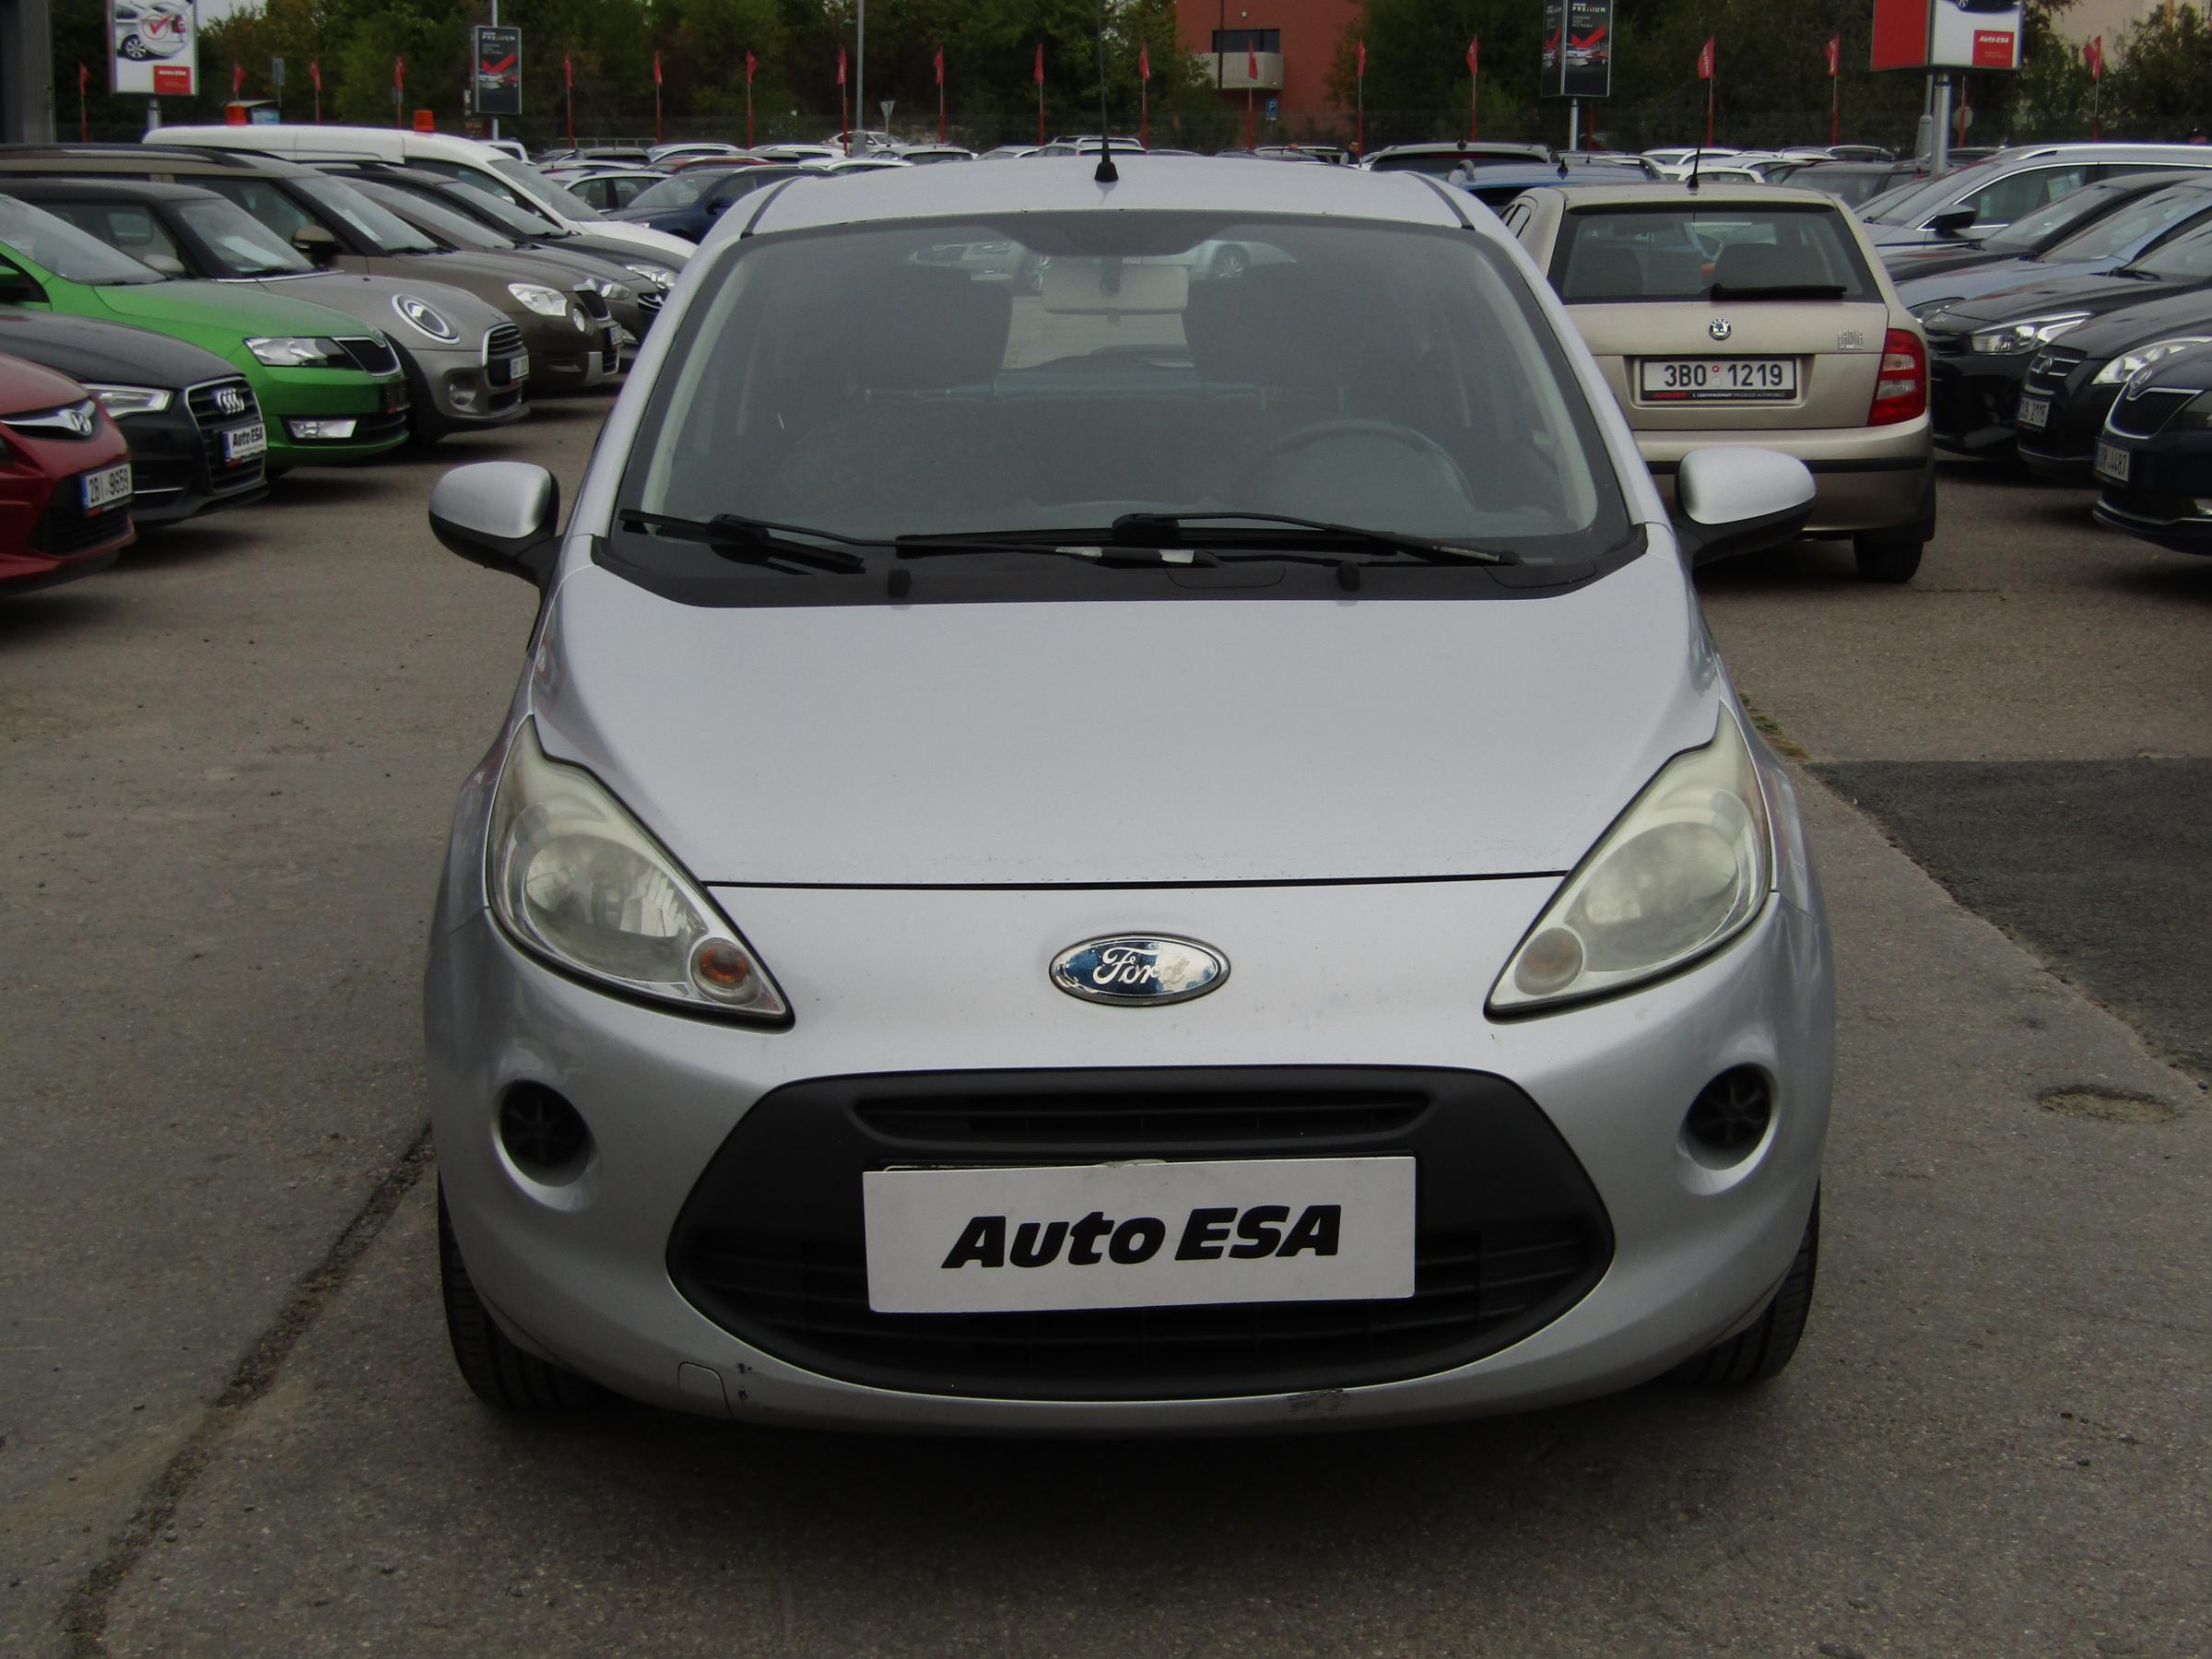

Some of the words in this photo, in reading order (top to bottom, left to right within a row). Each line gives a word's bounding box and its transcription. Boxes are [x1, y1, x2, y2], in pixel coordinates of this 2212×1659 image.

[1727, 363, 1783, 387] 1219
[232, 430, 251, 448] Auto
[251, 427, 264, 442] ESA
[1092, 946, 1191, 985] Ford
[941, 1211, 1166, 1269] Auto
[1174, 1204, 1342, 1261] ESA
